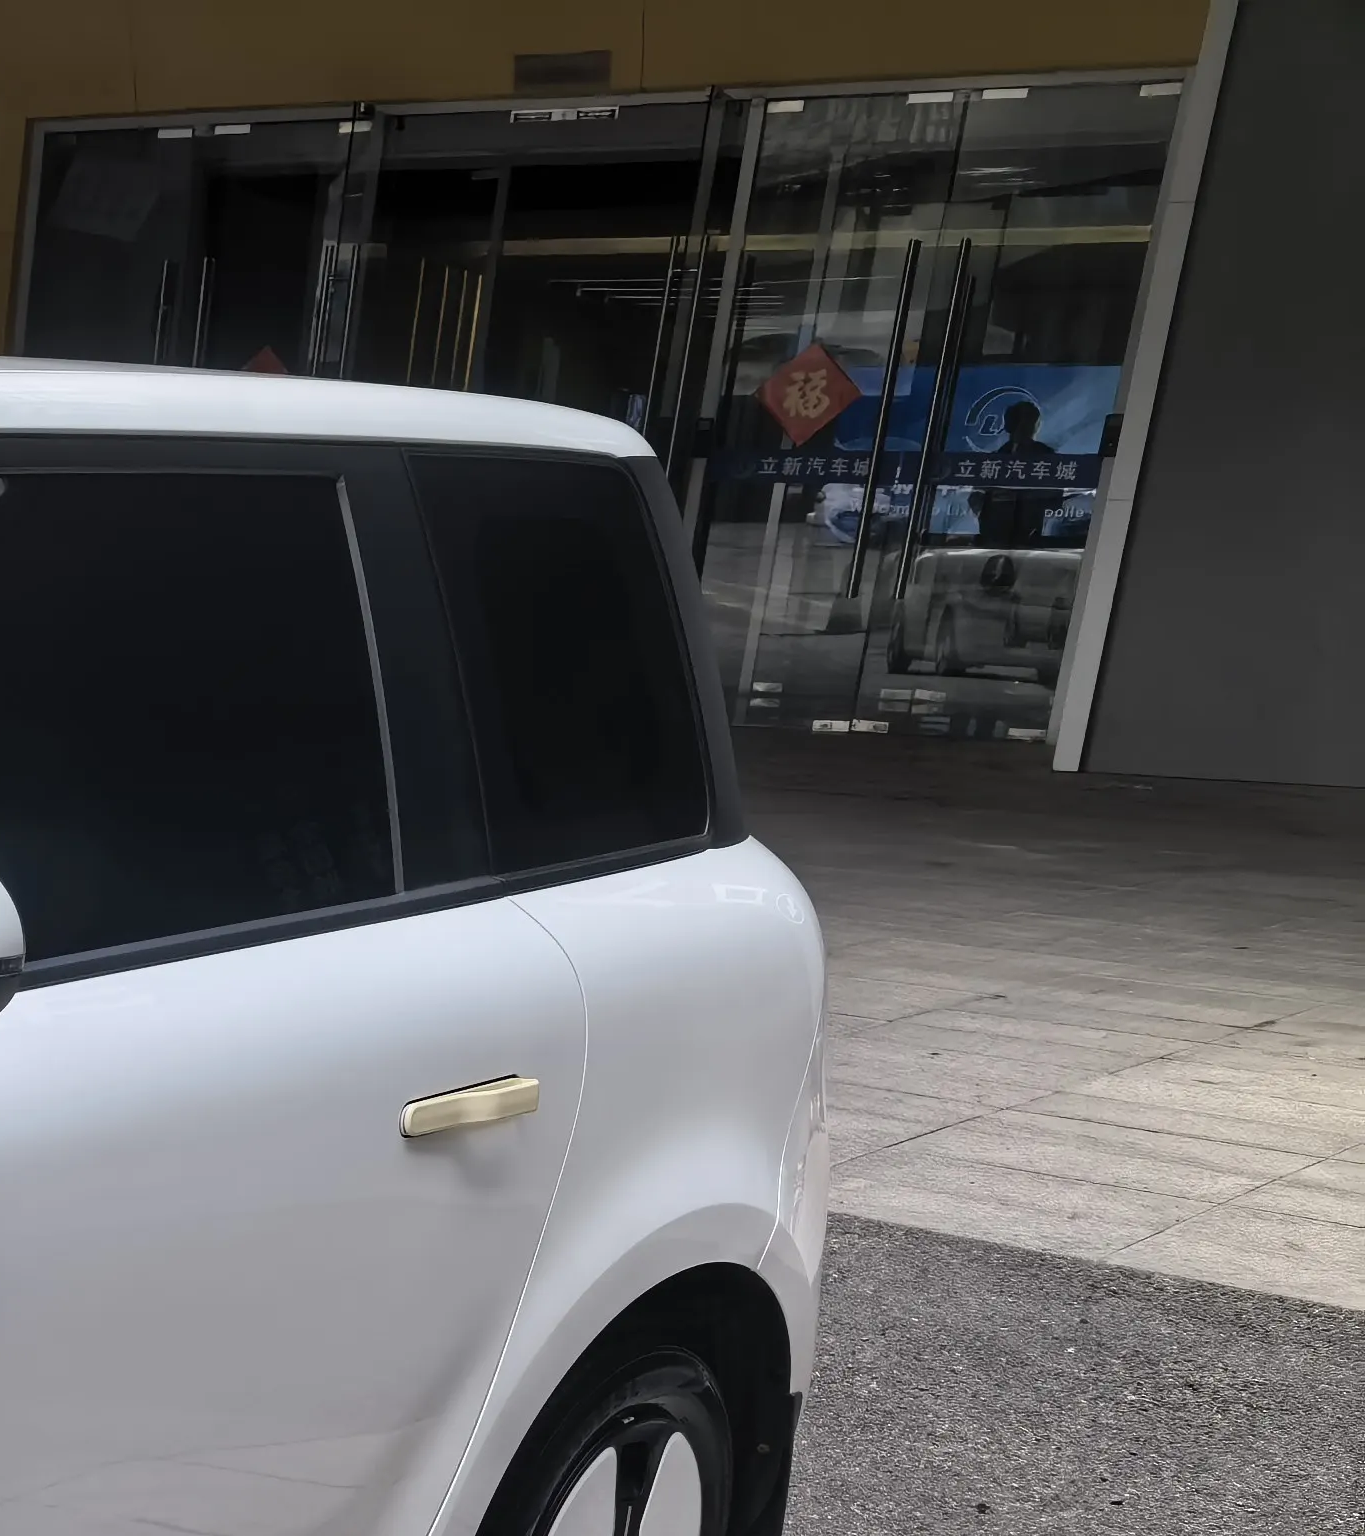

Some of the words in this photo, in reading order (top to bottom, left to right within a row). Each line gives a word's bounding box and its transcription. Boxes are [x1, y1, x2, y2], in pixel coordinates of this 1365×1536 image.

[782, 369, 830, 419] 福
[757, 456, 871, 477] 立新汽车城
[954, 459, 1080, 481] 立新汽车城
